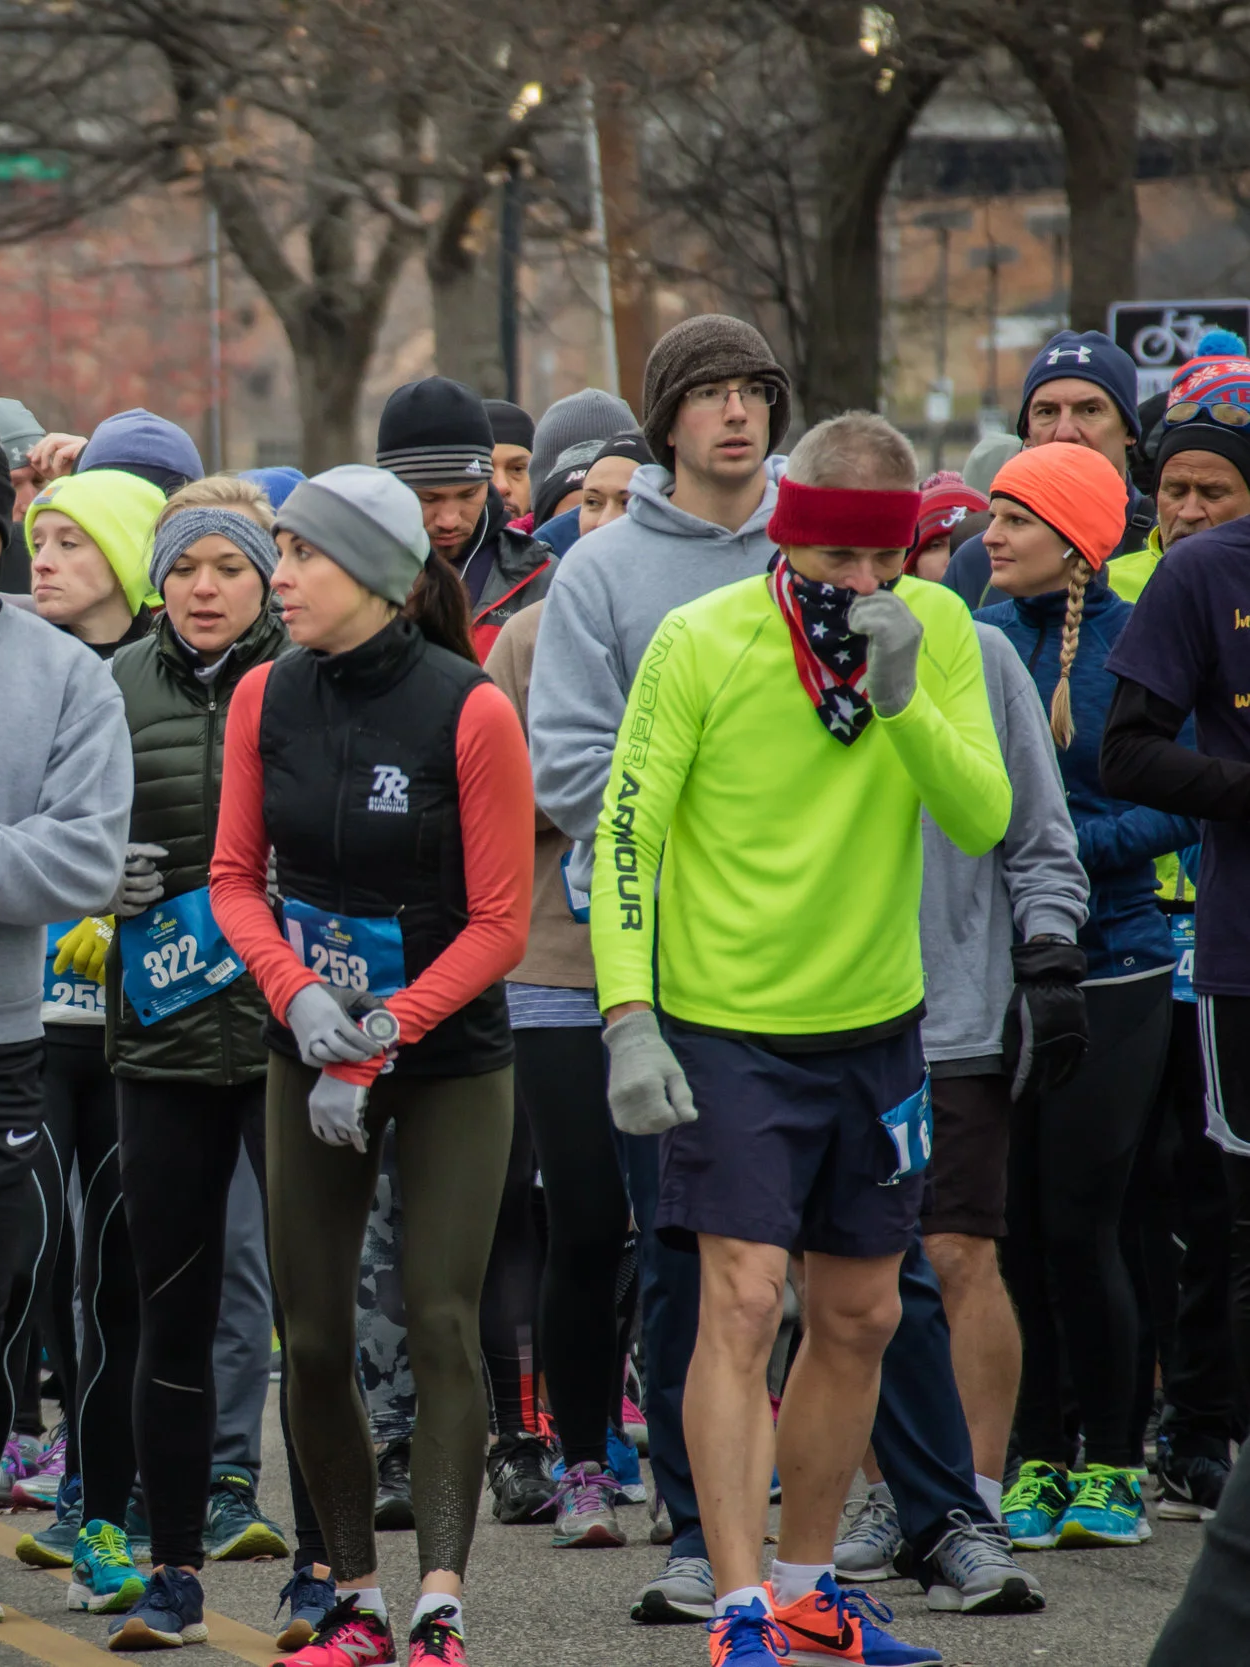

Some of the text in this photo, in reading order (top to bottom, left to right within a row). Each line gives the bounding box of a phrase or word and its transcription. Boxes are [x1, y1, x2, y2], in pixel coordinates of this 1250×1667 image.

[611, 616, 686, 931] UNDER ARMOUR
[369, 803, 408, 813] RUNNING
[143, 934, 207, 989] 322
[311, 943, 369, 993] 253
